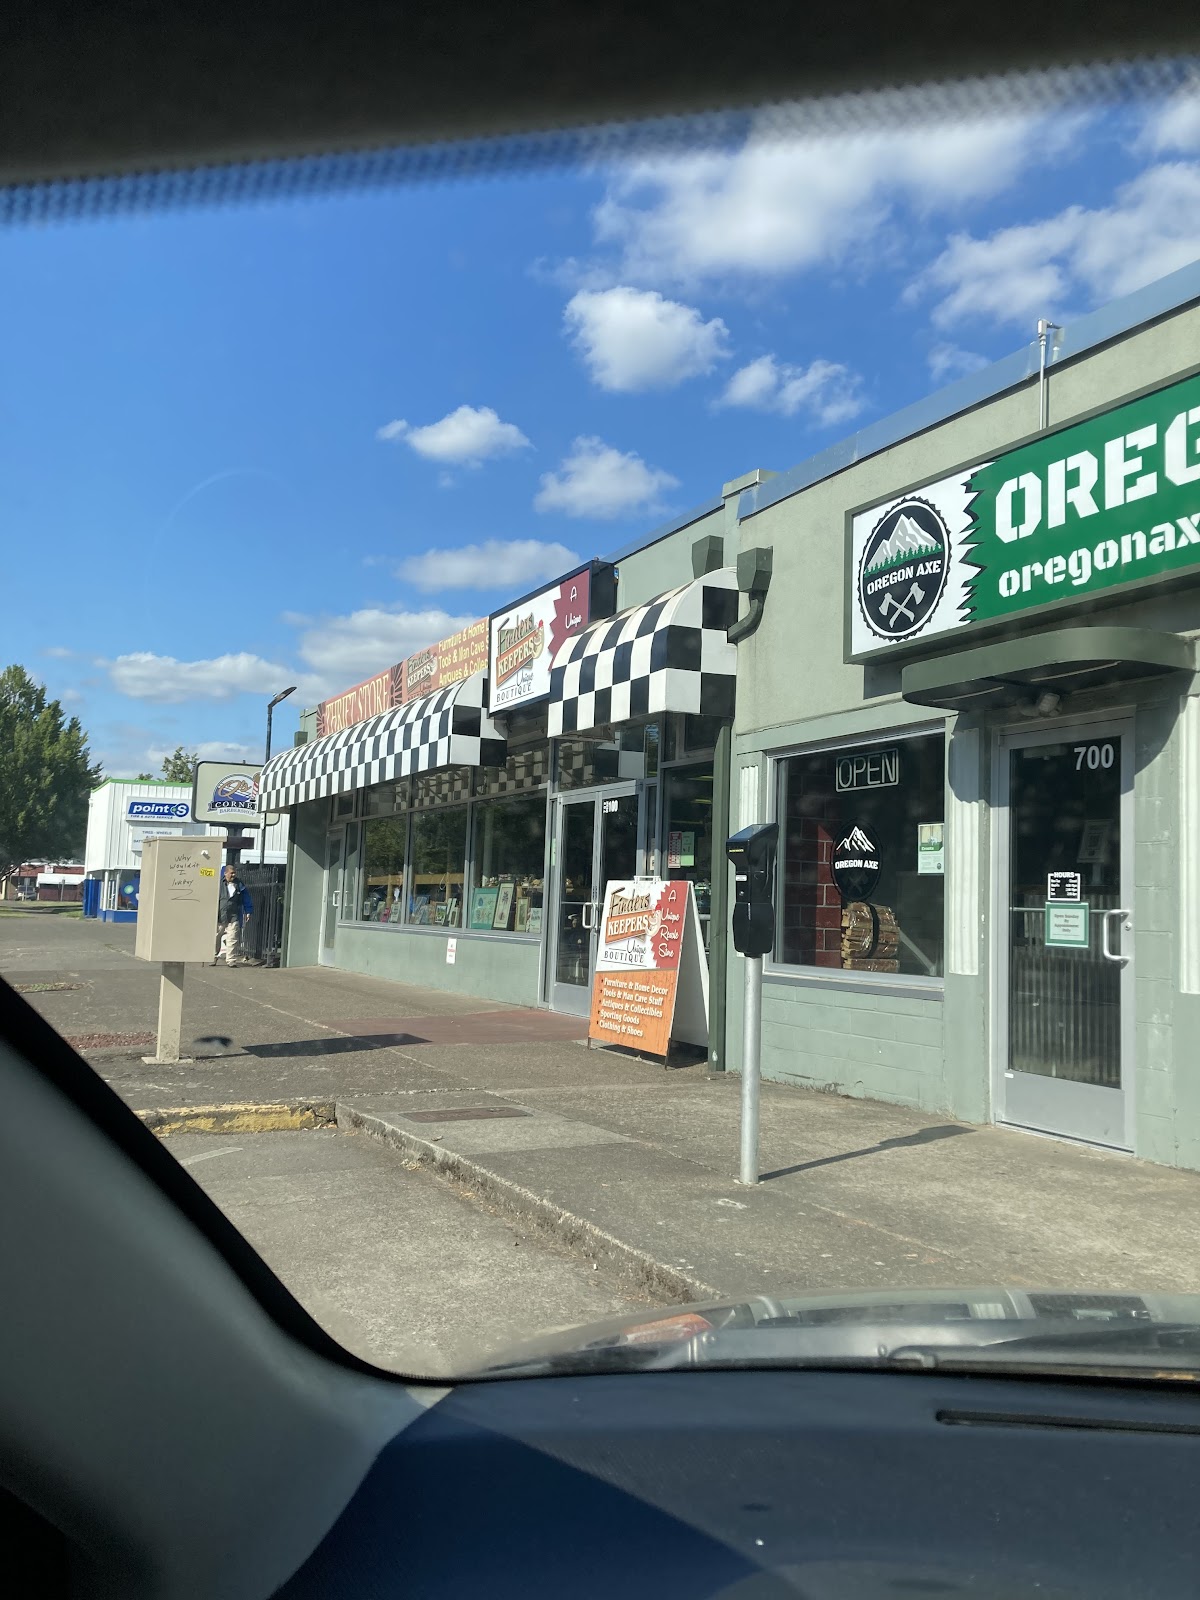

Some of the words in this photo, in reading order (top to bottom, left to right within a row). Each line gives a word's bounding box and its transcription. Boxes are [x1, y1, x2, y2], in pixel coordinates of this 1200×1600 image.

[866, 567, 914, 596] OREGON
[916, 559, 941, 580] AXE
[569, 585, 578, 602] A
[452, 649, 458, 663] &
[470, 640, 485, 656] Cave
[497, 637, 534, 678] KEEPERS
[407, 662, 431, 688] KEEPERS
[463, 662, 469, 677] &
[496, 682, 532, 703] BOUTIQUE
[325, 689, 357, 736] THRIFT
[358, 673, 389, 722] STORE
[1073, 743, 1115, 771] 700
[838, 751, 896, 788] OPEN
[133, 804, 170, 813] point
[176, 804, 187, 815] S
[834, 859, 863, 870] OREGON
[863, 860, 879, 870] AXE
[1053, 871, 1075, 879] HOURS
[609, 886, 651, 918] Finders
[668, 889, 677, 903] A
[607, 915, 649, 936] KEEPERS
[604, 951, 644, 963] BOUTIQUE
[626, 940, 647, 956] Unique
[604, 977, 628, 989] Furniture
[628, 981, 634, 990] &
[634, 982, 650, 993] Home
[651, 984, 669, 996] Decor
[602, 988, 616, 998] Tools
[617, 990, 622, 999] &
[622, 991, 634, 1001] Man
[634, 993, 648, 1003] Cave
[649, 995, 664, 1006] Stuff
[600, 1008, 622, 1022] Sporting
[622, 1013, 640, 1025] Goods
[601, 998, 624, 1010] Antiques
[624, 1002, 629, 1011] &
[630, 1003, 663, 1018] Collectibles
[599, 1019, 621, 1034] Clothing
[621, 1024, 627, 1033] &
[627, 1025, 644, 1037] Shoes
